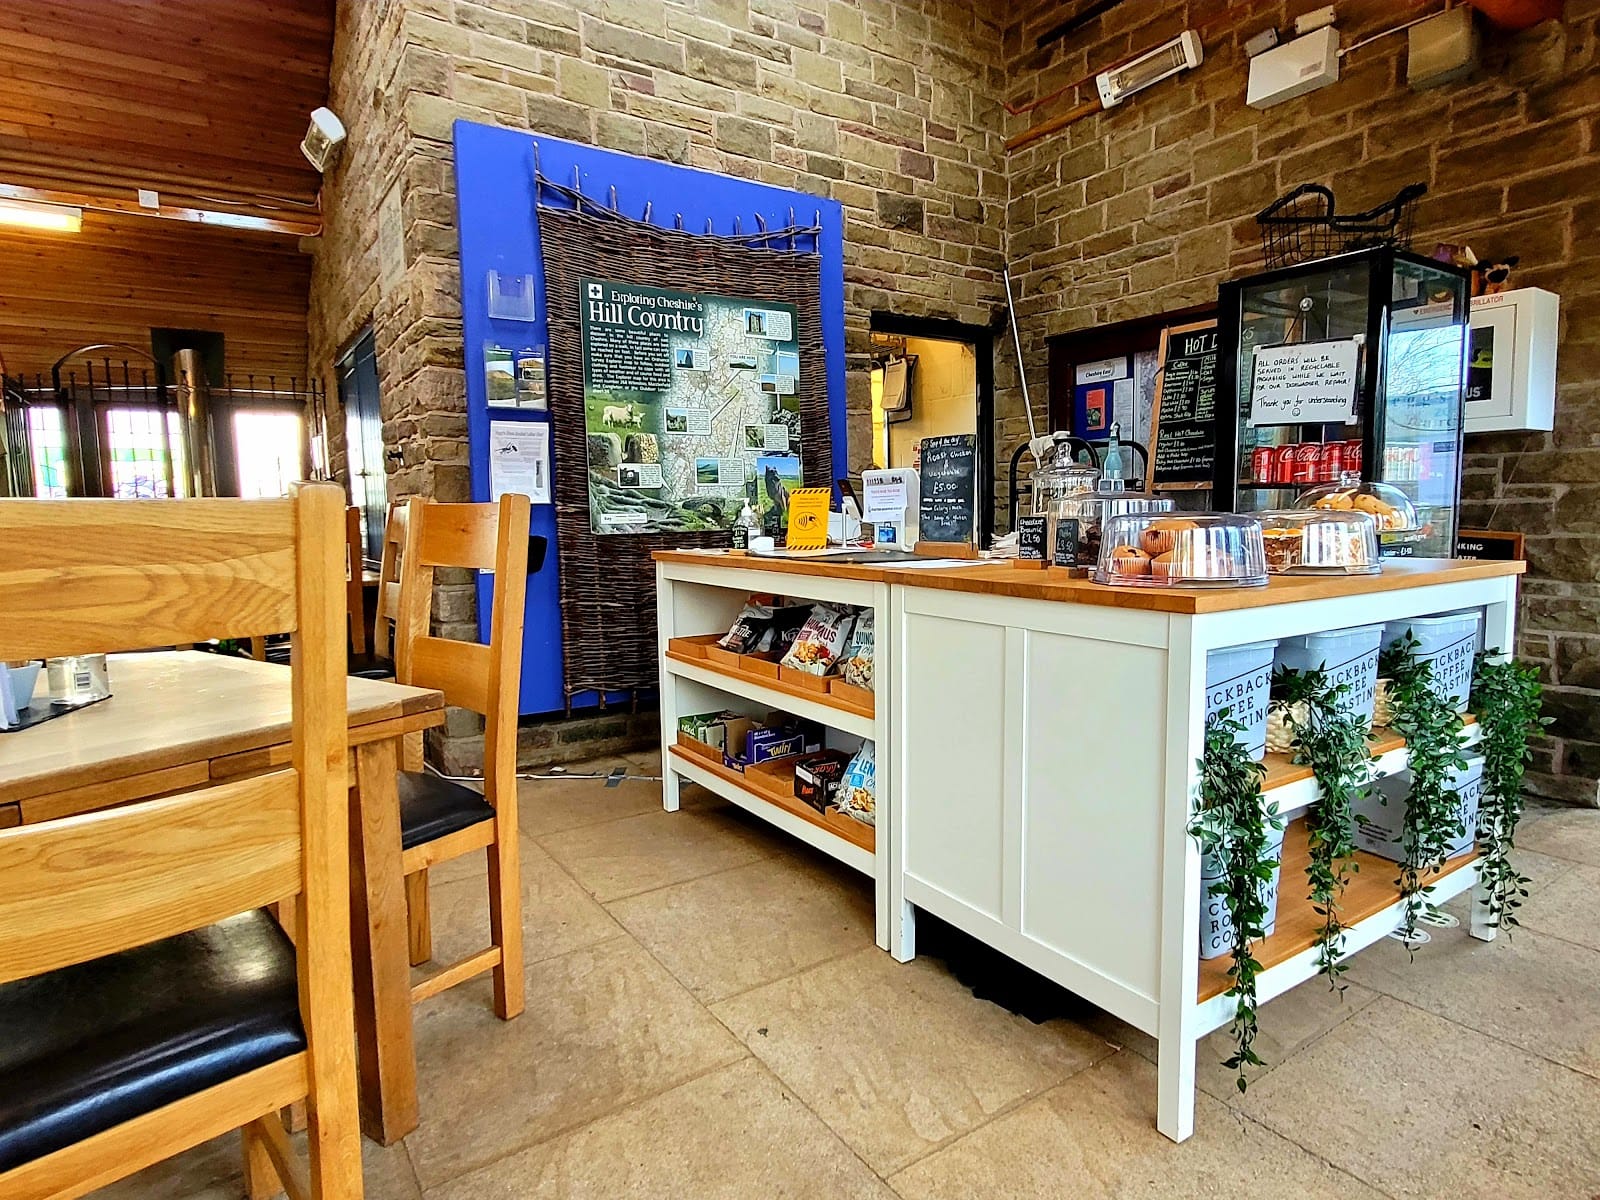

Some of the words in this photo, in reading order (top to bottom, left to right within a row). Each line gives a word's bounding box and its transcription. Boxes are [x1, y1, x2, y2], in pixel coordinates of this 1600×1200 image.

[611, 290, 655, 309] Exploring
[657, 296, 703, 312] Cheshire's
[588, 300, 624, 325] Hill
[627, 305, 704, 338] Country
[1185, 335, 1208, 354] HOT
[1273, 357, 1299, 366] ORDERS
[1300, 362, 1341, 371] RECYCLABLE
[1257, 395, 1279, 408] Thank
[1281, 399, 1292, 410] you
[1293, 394, 1304, 407] for
[1434, 659, 1465, 682] OFFEE
[1207, 671, 1272, 709] ICKBACK
